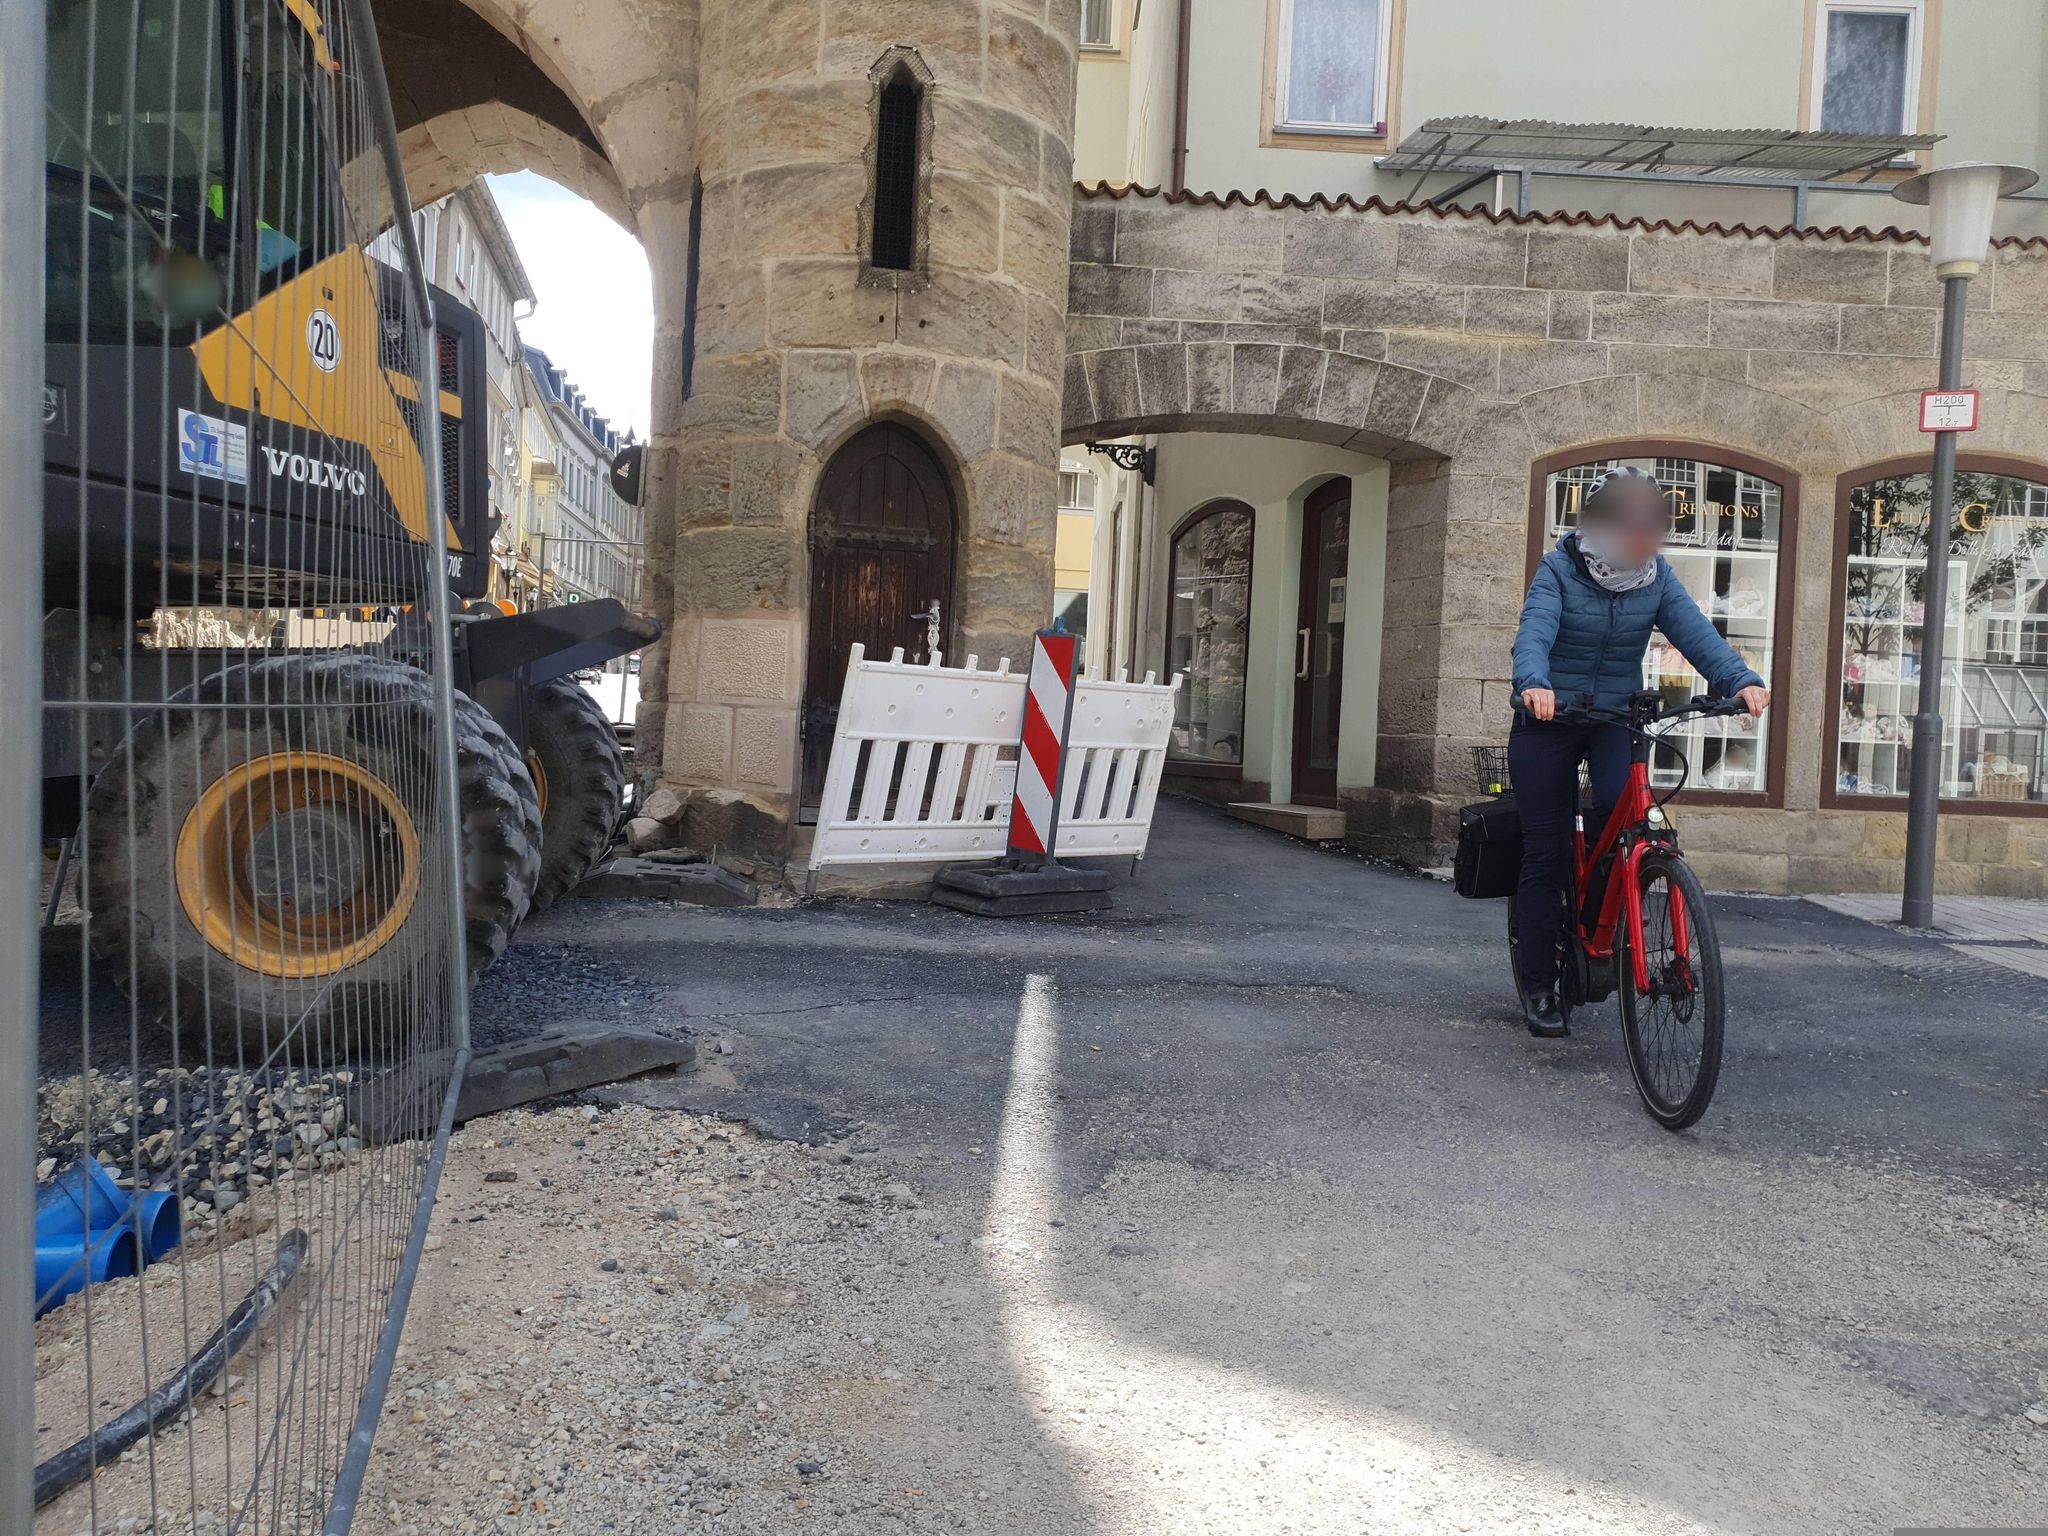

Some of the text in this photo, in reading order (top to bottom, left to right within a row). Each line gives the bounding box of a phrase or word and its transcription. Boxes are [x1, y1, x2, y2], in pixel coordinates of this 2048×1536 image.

[314, 319, 334, 361] 20
[1934, 395, 1964, 404] H200
[181, 414, 222, 468] STL
[261, 446, 366, 496] VOLVO
